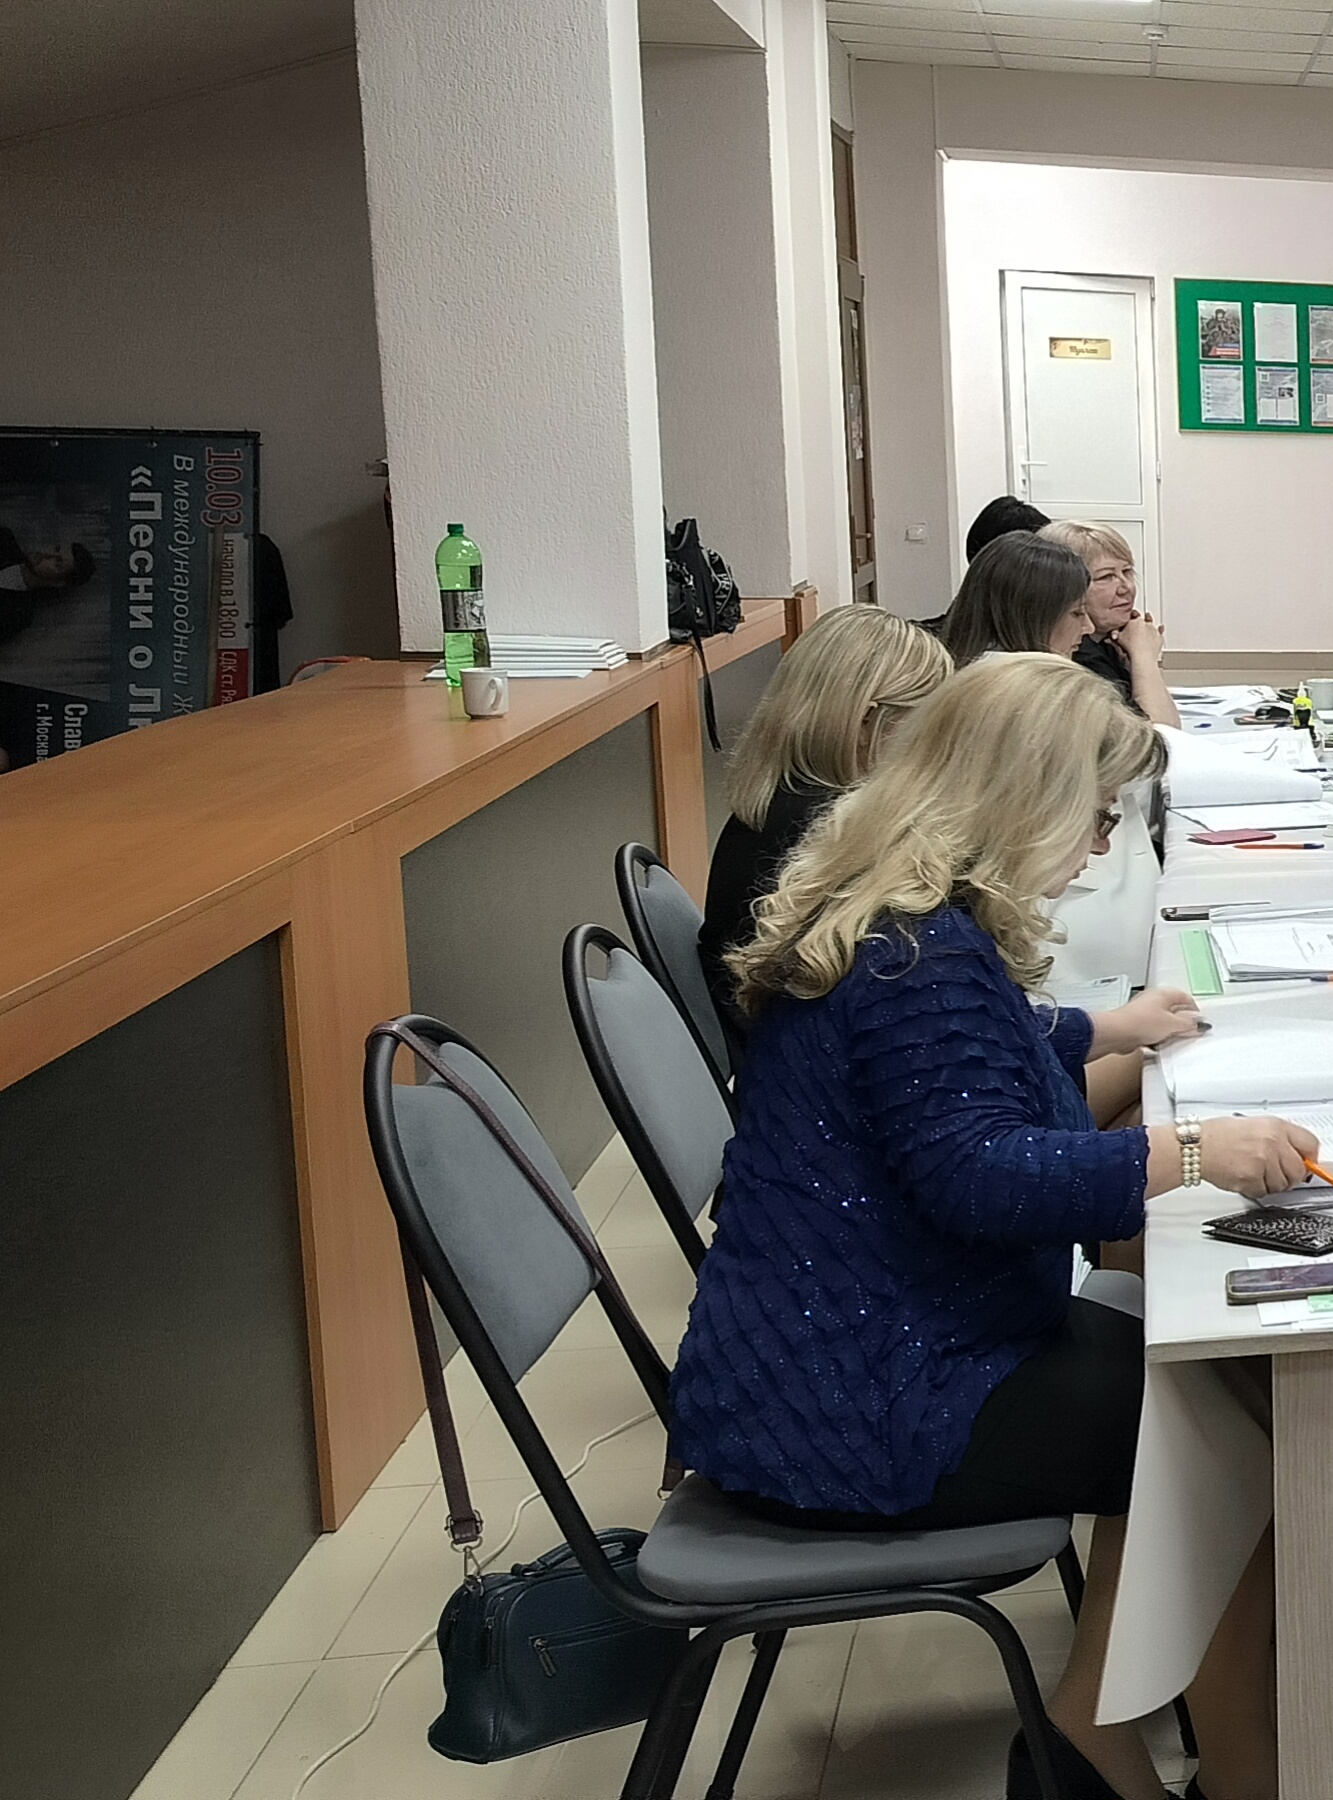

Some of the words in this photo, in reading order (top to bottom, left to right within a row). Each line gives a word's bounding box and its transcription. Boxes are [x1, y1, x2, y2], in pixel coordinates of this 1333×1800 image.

[173, 454, 195, 472] В
[201, 447, 243, 528] 10.03
[128, 465, 162, 629] «Песни
[219, 588, 234, 599] в
[218, 601, 239, 640] 18:00
[128, 644, 154, 670] о
[218, 651, 238, 673] СДК
[220, 674, 234, 688] ст.
